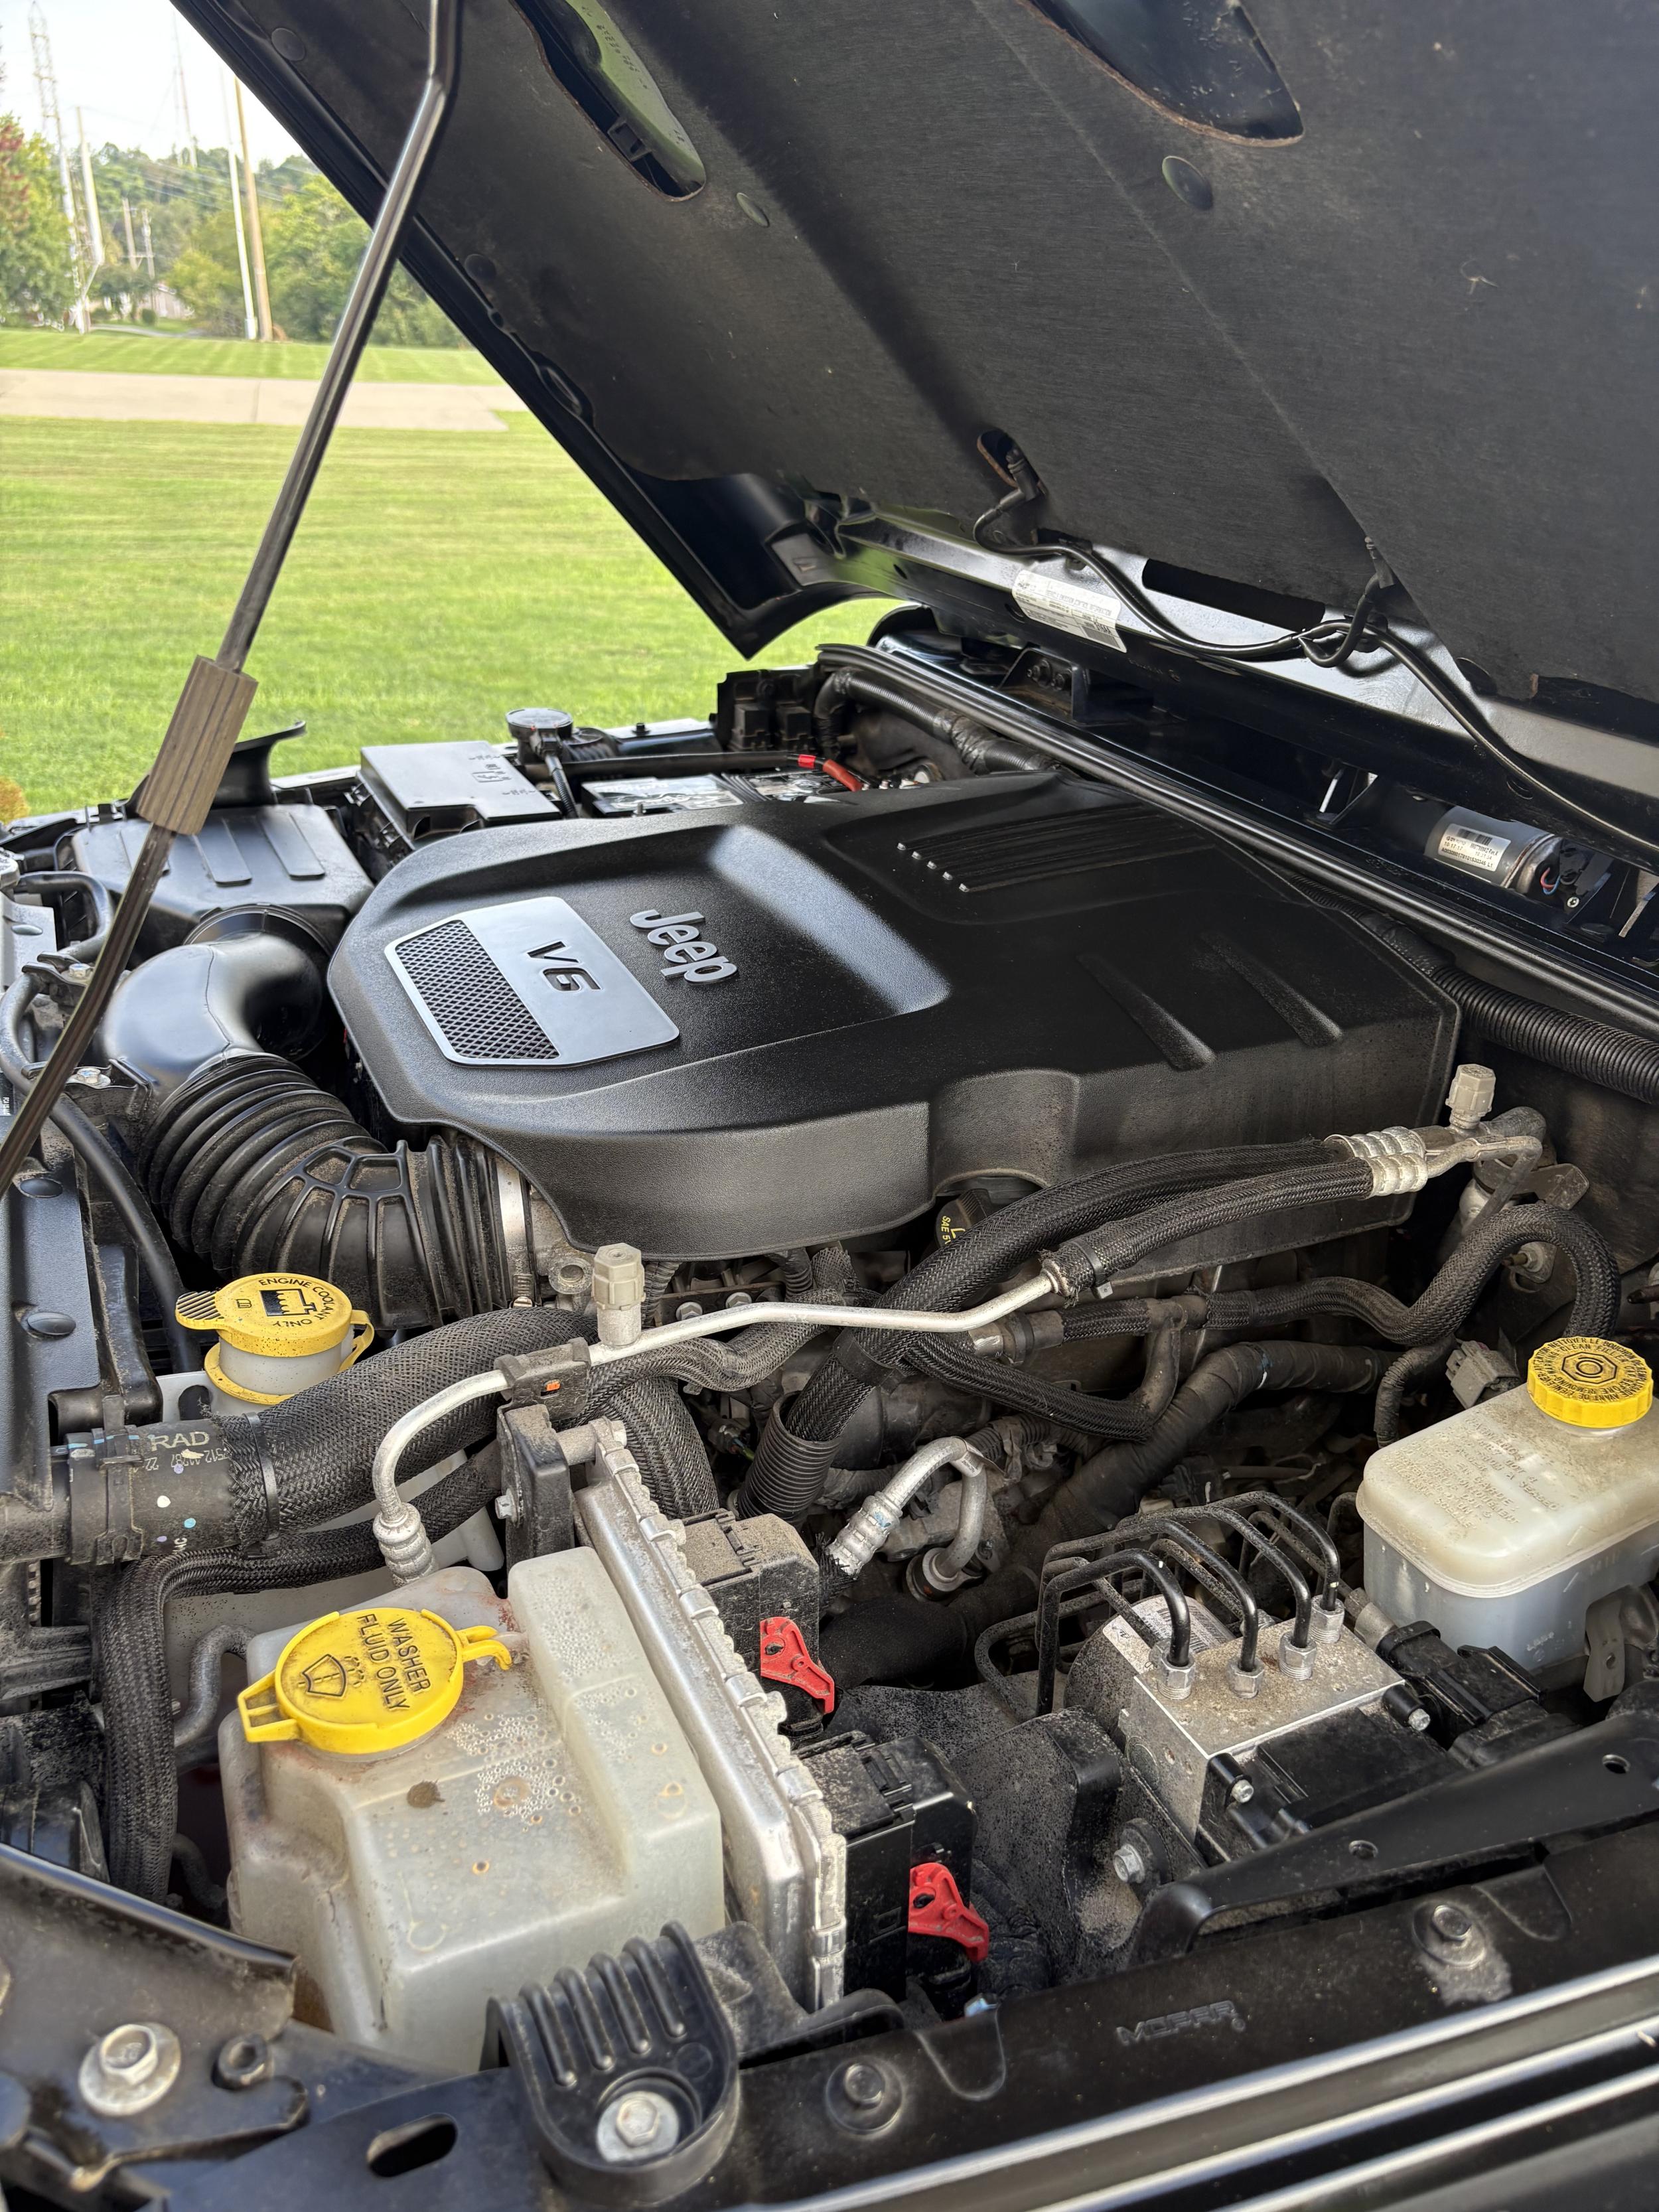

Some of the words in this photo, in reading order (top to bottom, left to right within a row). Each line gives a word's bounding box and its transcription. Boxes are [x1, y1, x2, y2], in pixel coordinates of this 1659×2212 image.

[630, 909, 738, 984] Jeep
[527, 940, 603, 993] V6
[940, 1215, 951, 1233] SAE
[259, 1278, 312, 1288] ENGINE
[313, 1286, 336, 1321] COOLANT
[273, 1318, 313, 1327] ONLY
[1596, 1345, 1626, 1364] FILLER
[1603, 1341, 1636, 1362] BOUCHON
[1624, 1364, 1636, 1378] CAP
[1599, 1378, 1633, 1395] BEFORE
[149, 1431, 210, 1452] RAD
[356, 1613, 390, 1664] FLUID
[376, 1665, 411, 1713] ONLY
[387, 1617, 432, 1694] WASHER
